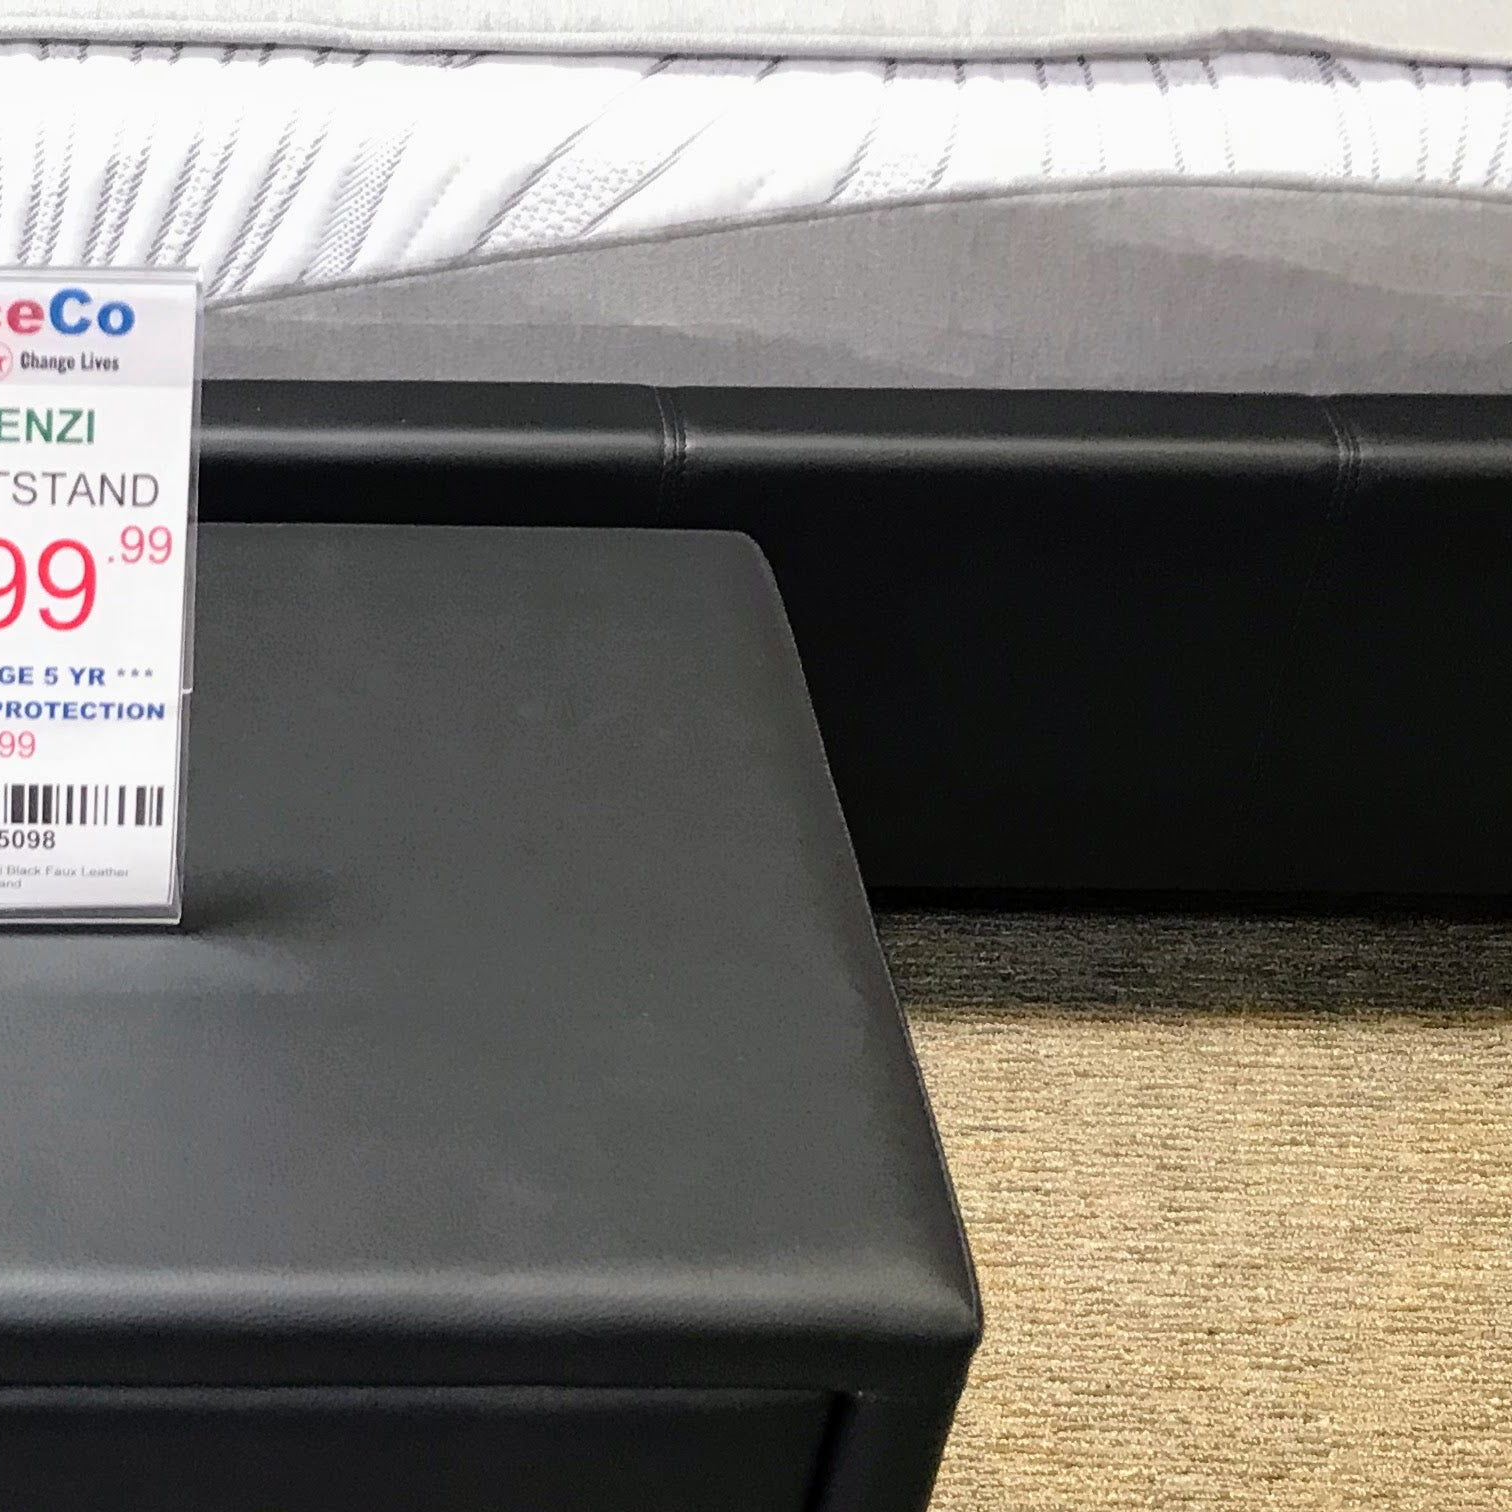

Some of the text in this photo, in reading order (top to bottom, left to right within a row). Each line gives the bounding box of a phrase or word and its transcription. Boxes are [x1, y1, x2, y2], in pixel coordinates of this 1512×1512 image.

[20, 350, 76, 372] Change
[81, 352, 120, 371] Lives
[44, 667, 59, 686] 5
[69, 667, 106, 686] YR
[7, 864, 41, 876] Black
[45, 865, 76, 877] Faux
[81, 866, 129, 878] Leather
